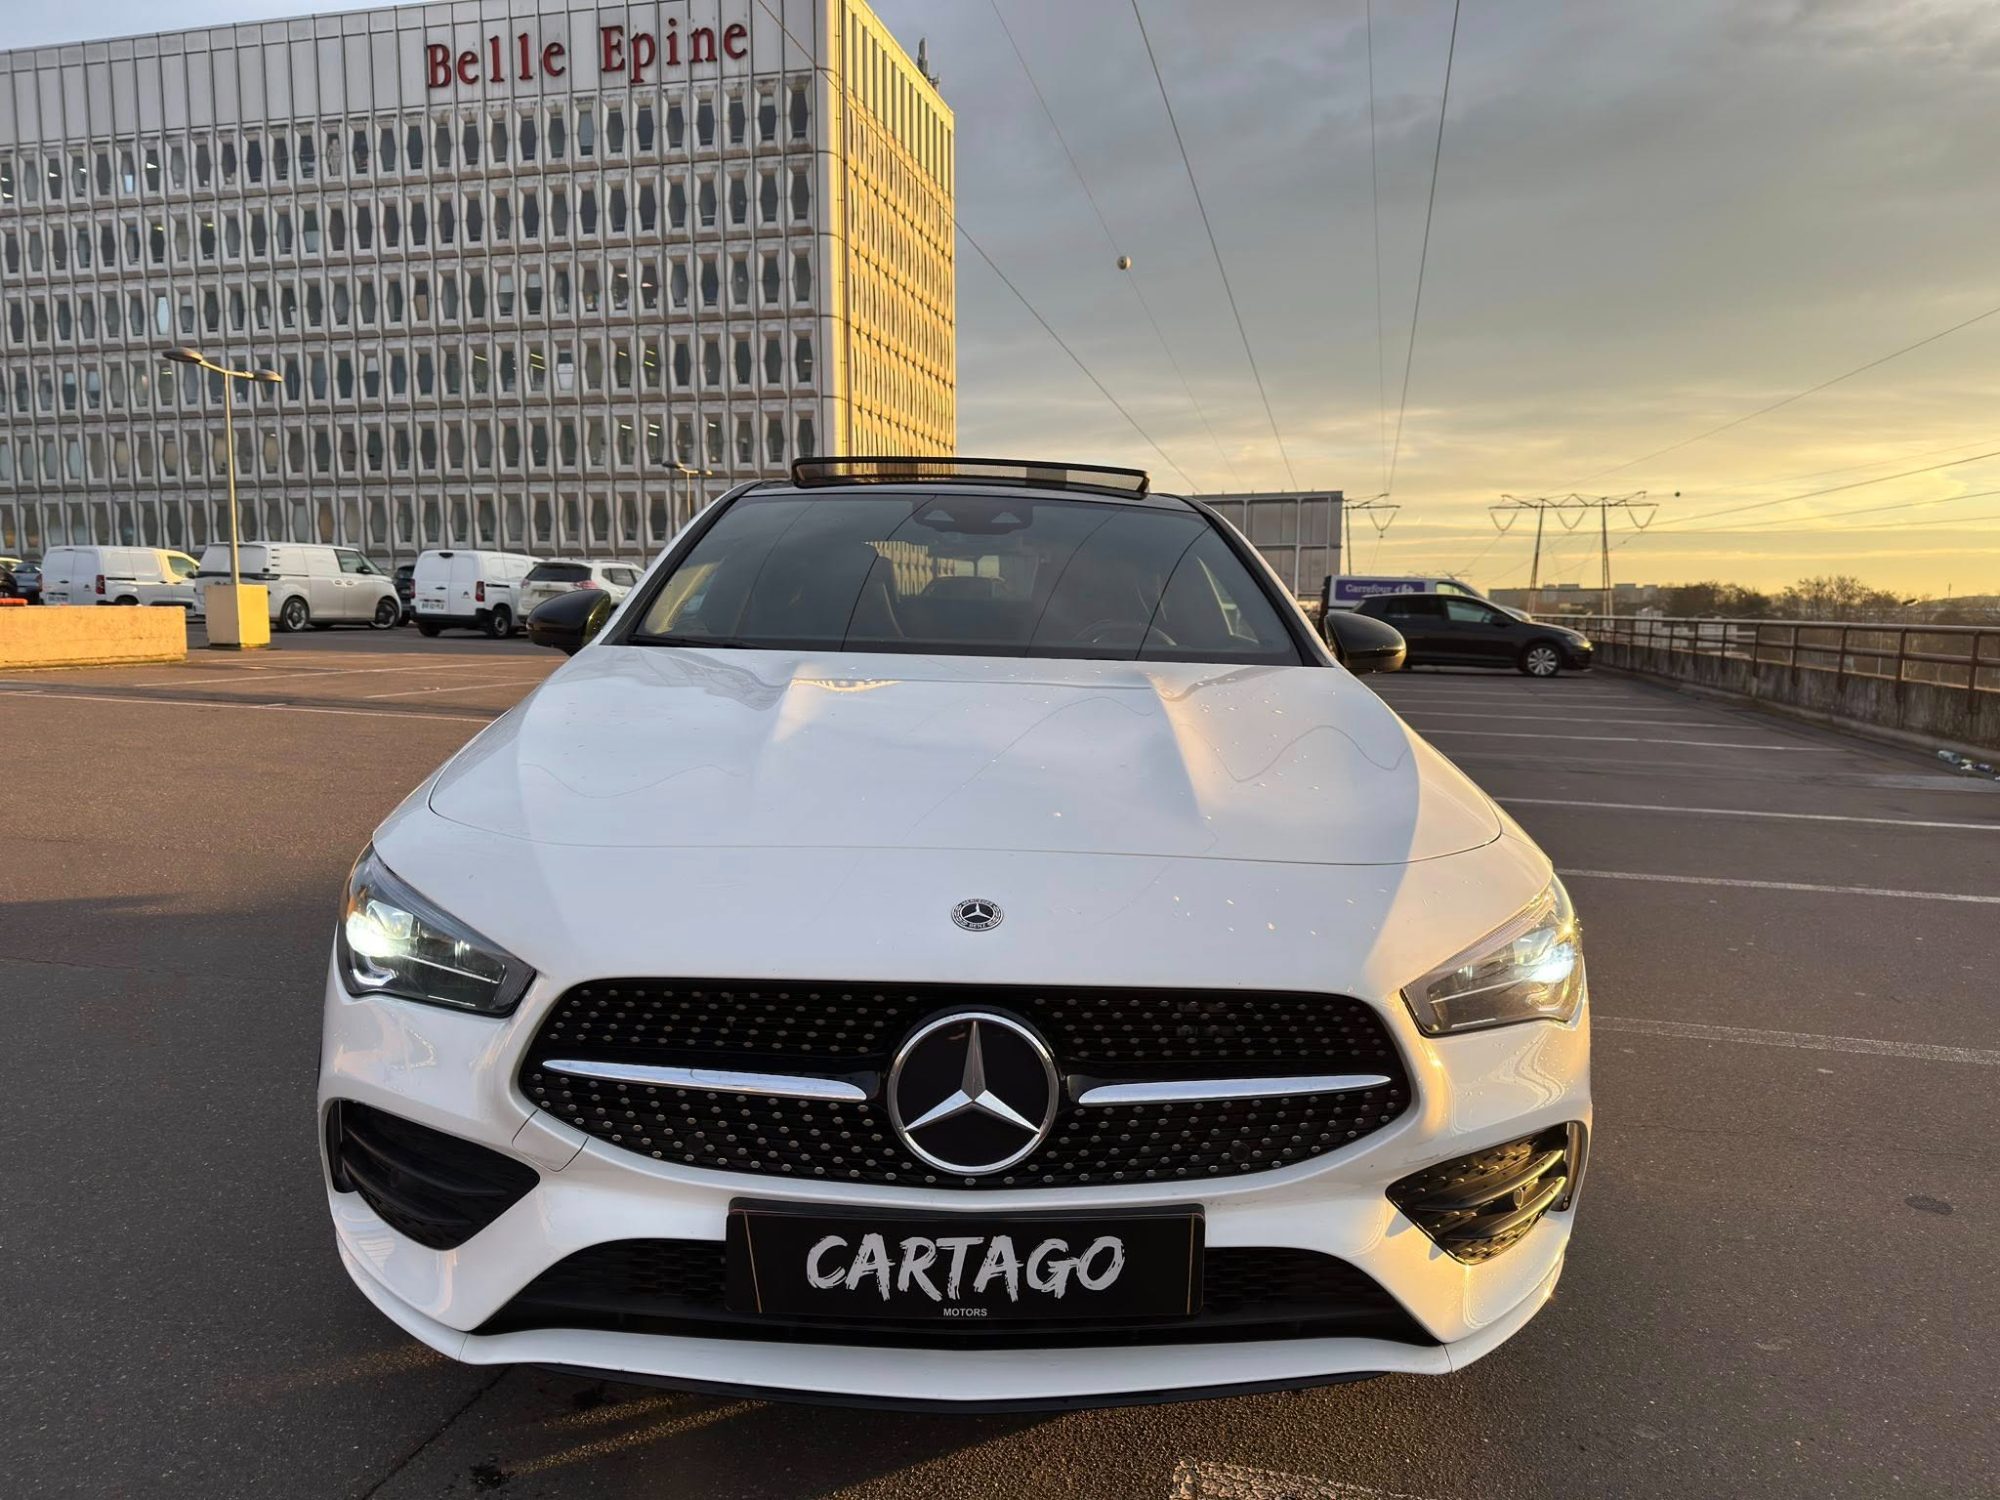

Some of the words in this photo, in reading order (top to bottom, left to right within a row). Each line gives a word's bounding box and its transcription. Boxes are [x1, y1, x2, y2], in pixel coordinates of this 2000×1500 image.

[427, 33, 566, 88] Belle
[600, 18, 748, 83] Epine
[1345, 583, 1393, 593] Carrefour
[806, 1233, 1126, 1302] CARTAGO
[943, 1308, 988, 1317] MOTORS
